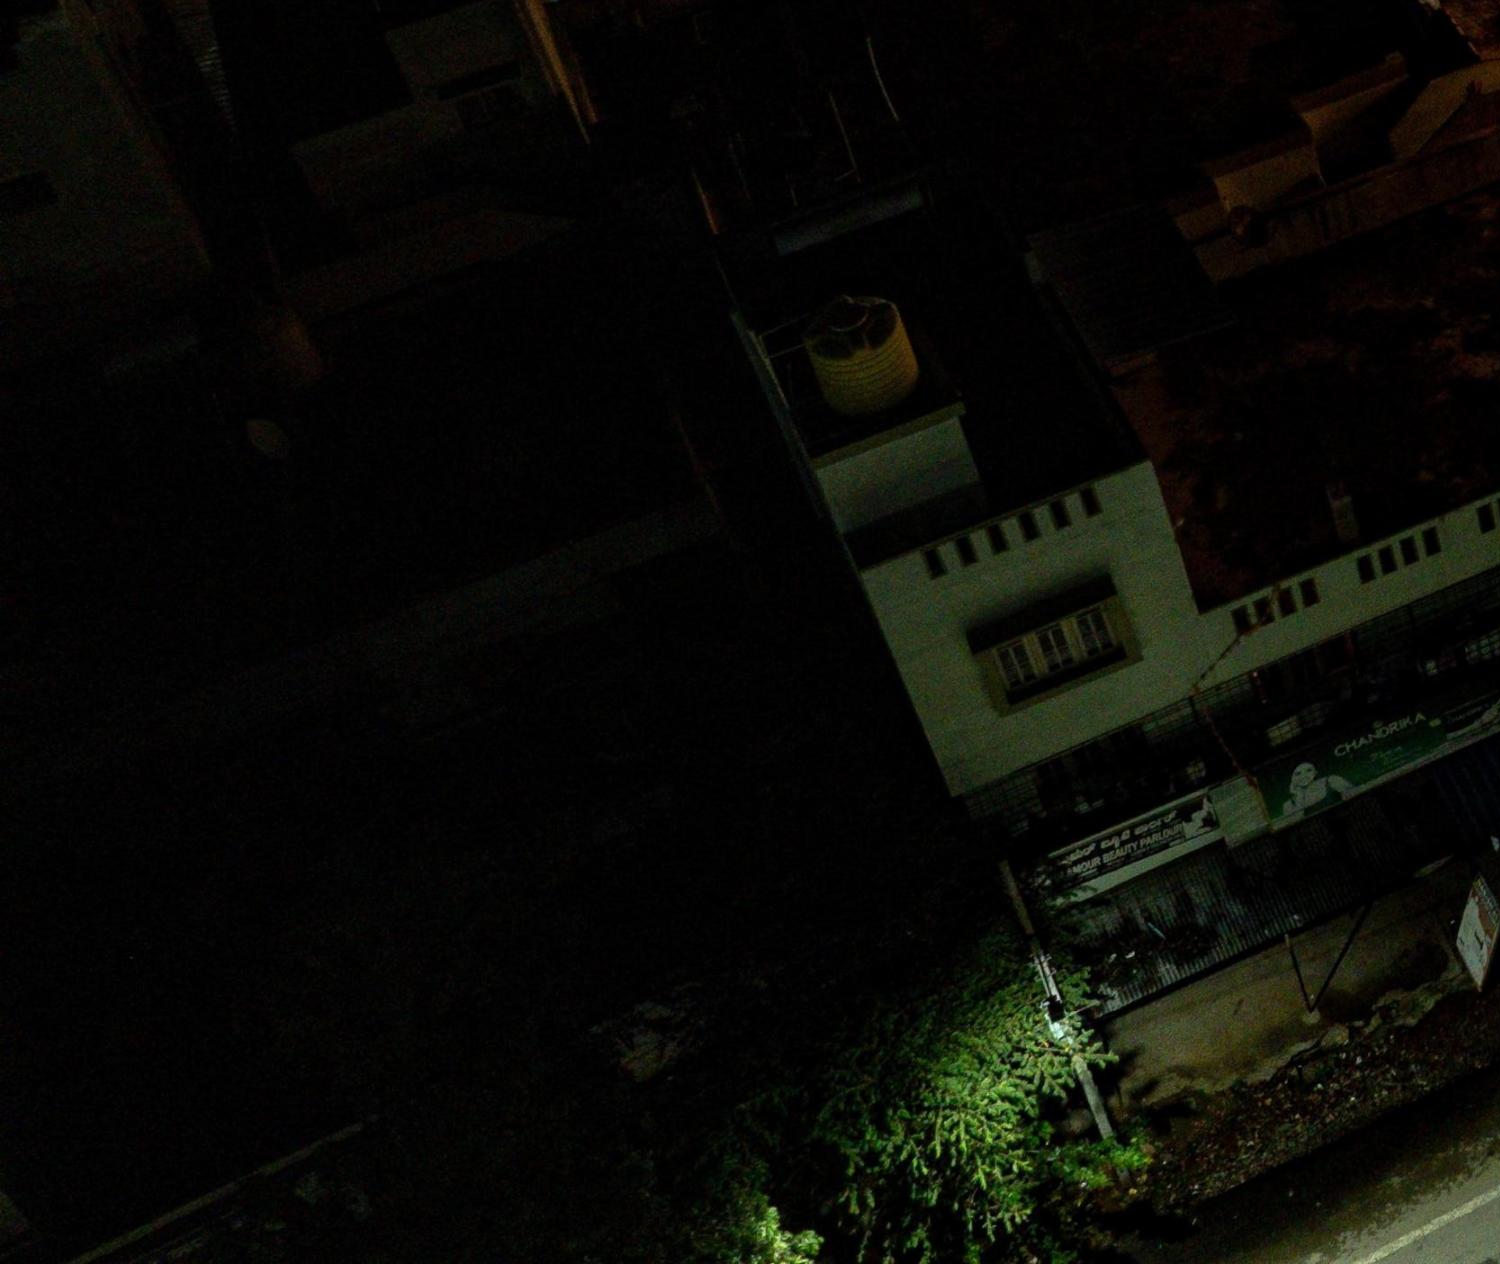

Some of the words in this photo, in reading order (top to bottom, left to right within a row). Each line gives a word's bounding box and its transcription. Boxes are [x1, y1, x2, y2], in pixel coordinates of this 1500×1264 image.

[1333, 711, 1427, 757] CHANDRIKA
[1102, 840, 1139, 864] BEAUTY
[1139, 821, 1185, 849] PARLOUR
